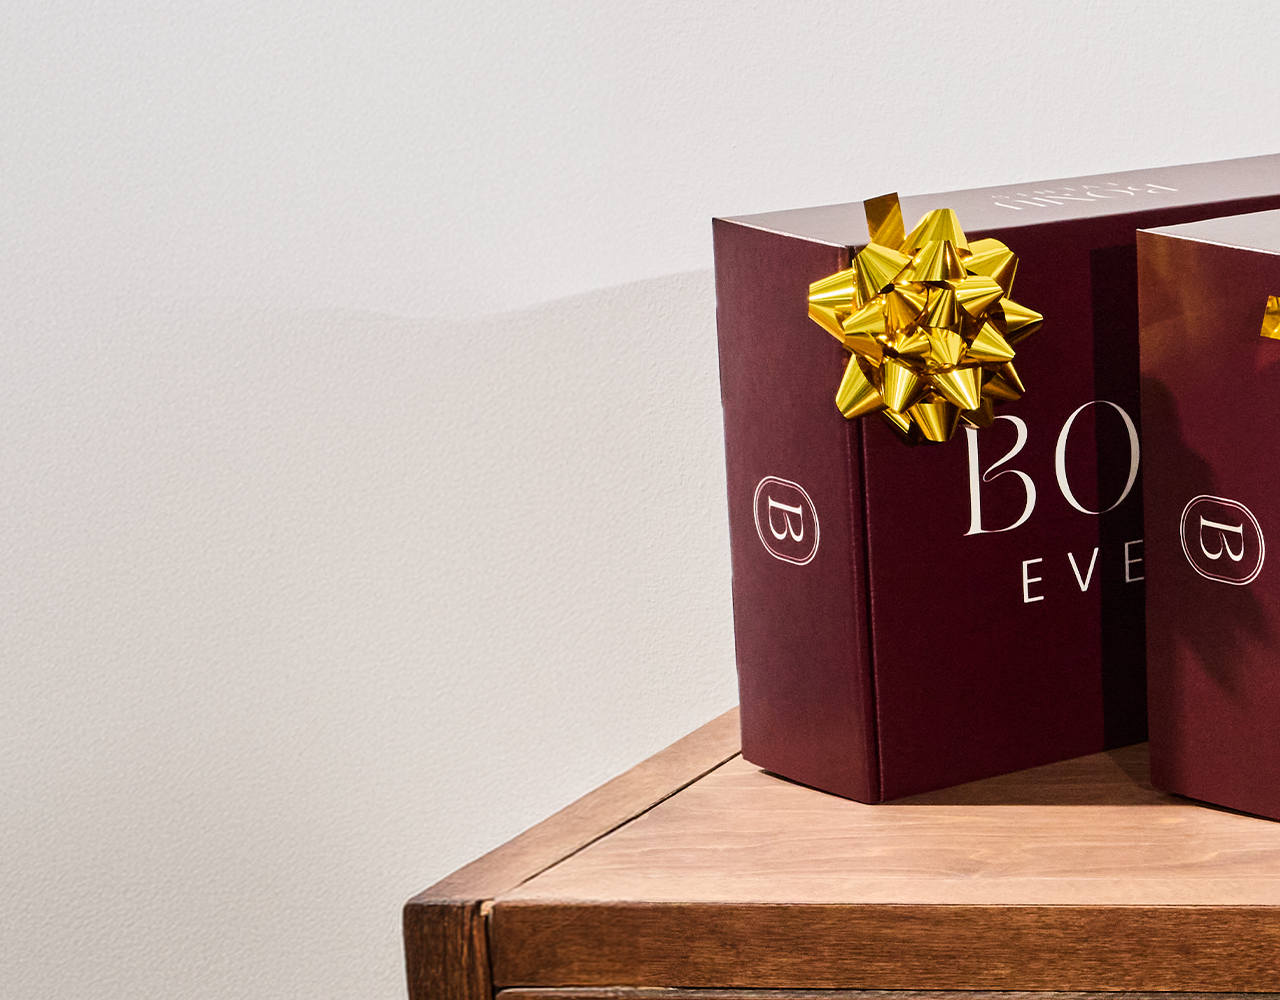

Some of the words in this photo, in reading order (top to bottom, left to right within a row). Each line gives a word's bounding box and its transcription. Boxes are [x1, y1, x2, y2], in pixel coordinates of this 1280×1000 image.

[766, 497, 803, 543] B
[1200, 515, 1245, 563] B
[1022, 539, 1144, 603] EVE
